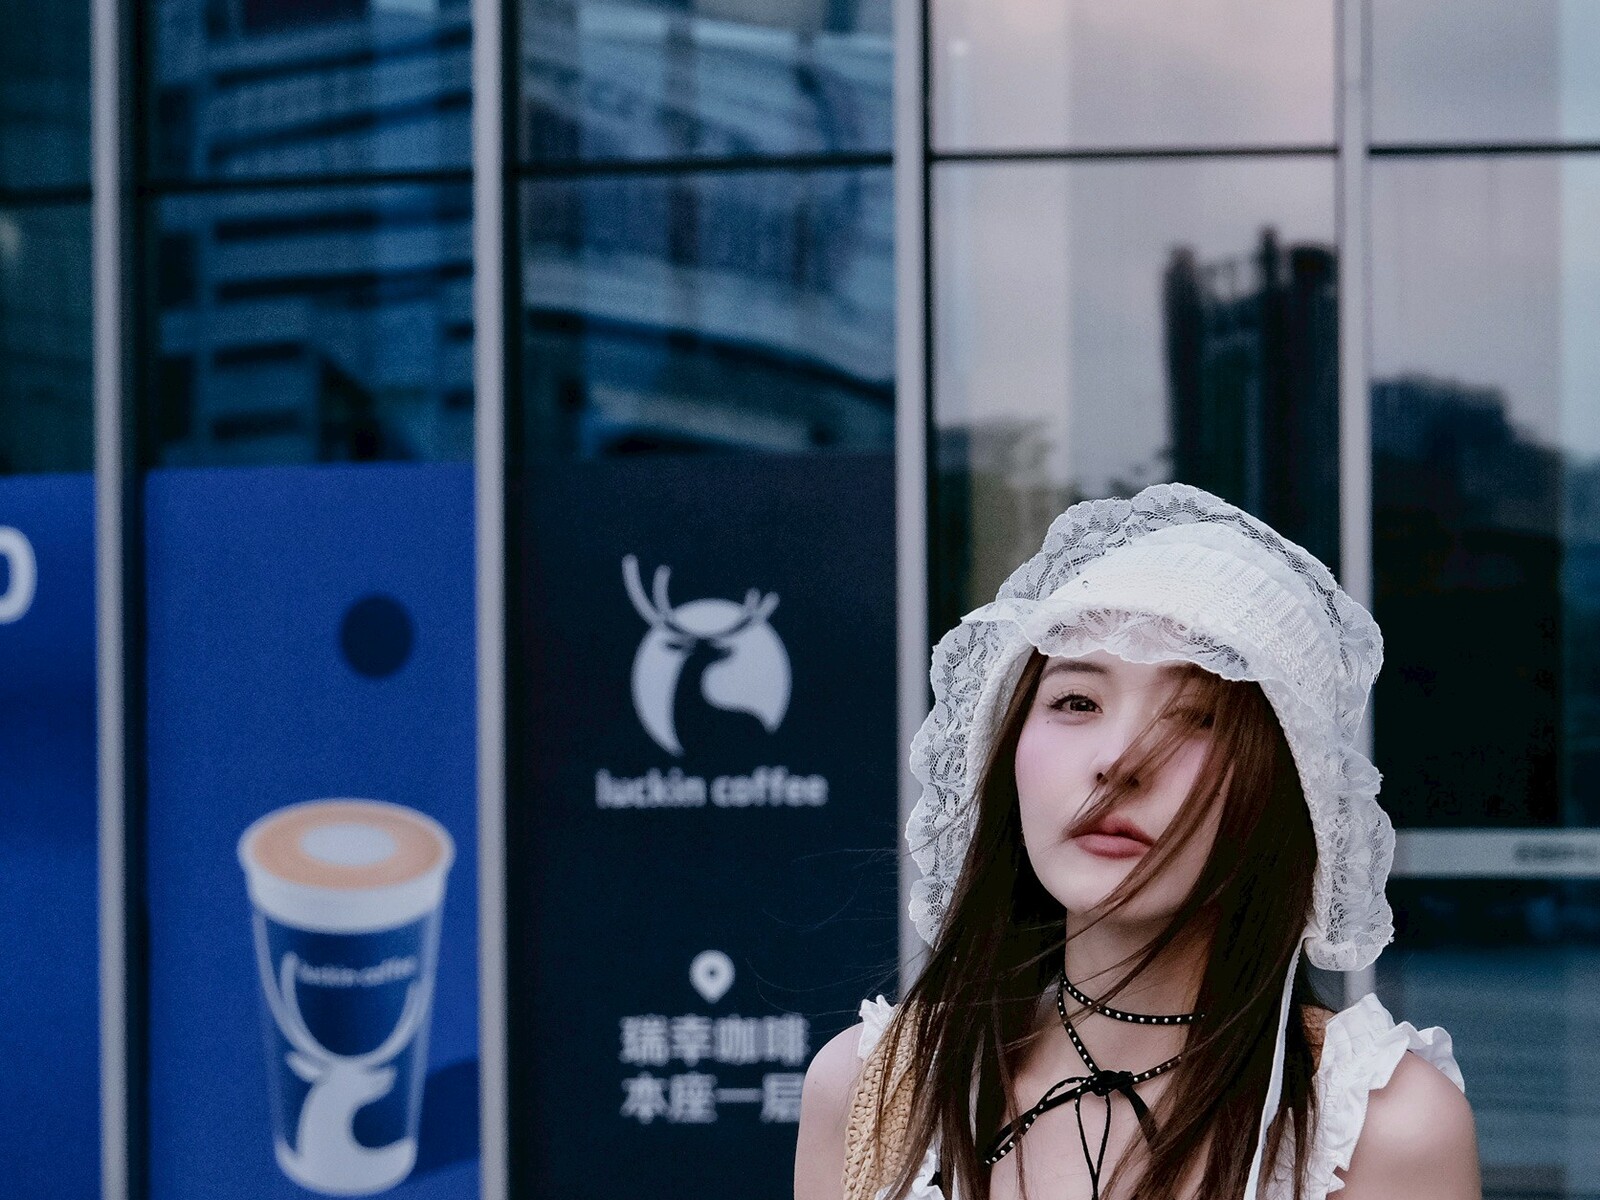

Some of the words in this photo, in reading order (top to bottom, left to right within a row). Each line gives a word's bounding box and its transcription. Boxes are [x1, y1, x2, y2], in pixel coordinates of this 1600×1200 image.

[710, 766, 829, 807] coffee
[619, 1014, 809, 1067] 瑞幸咖啡
